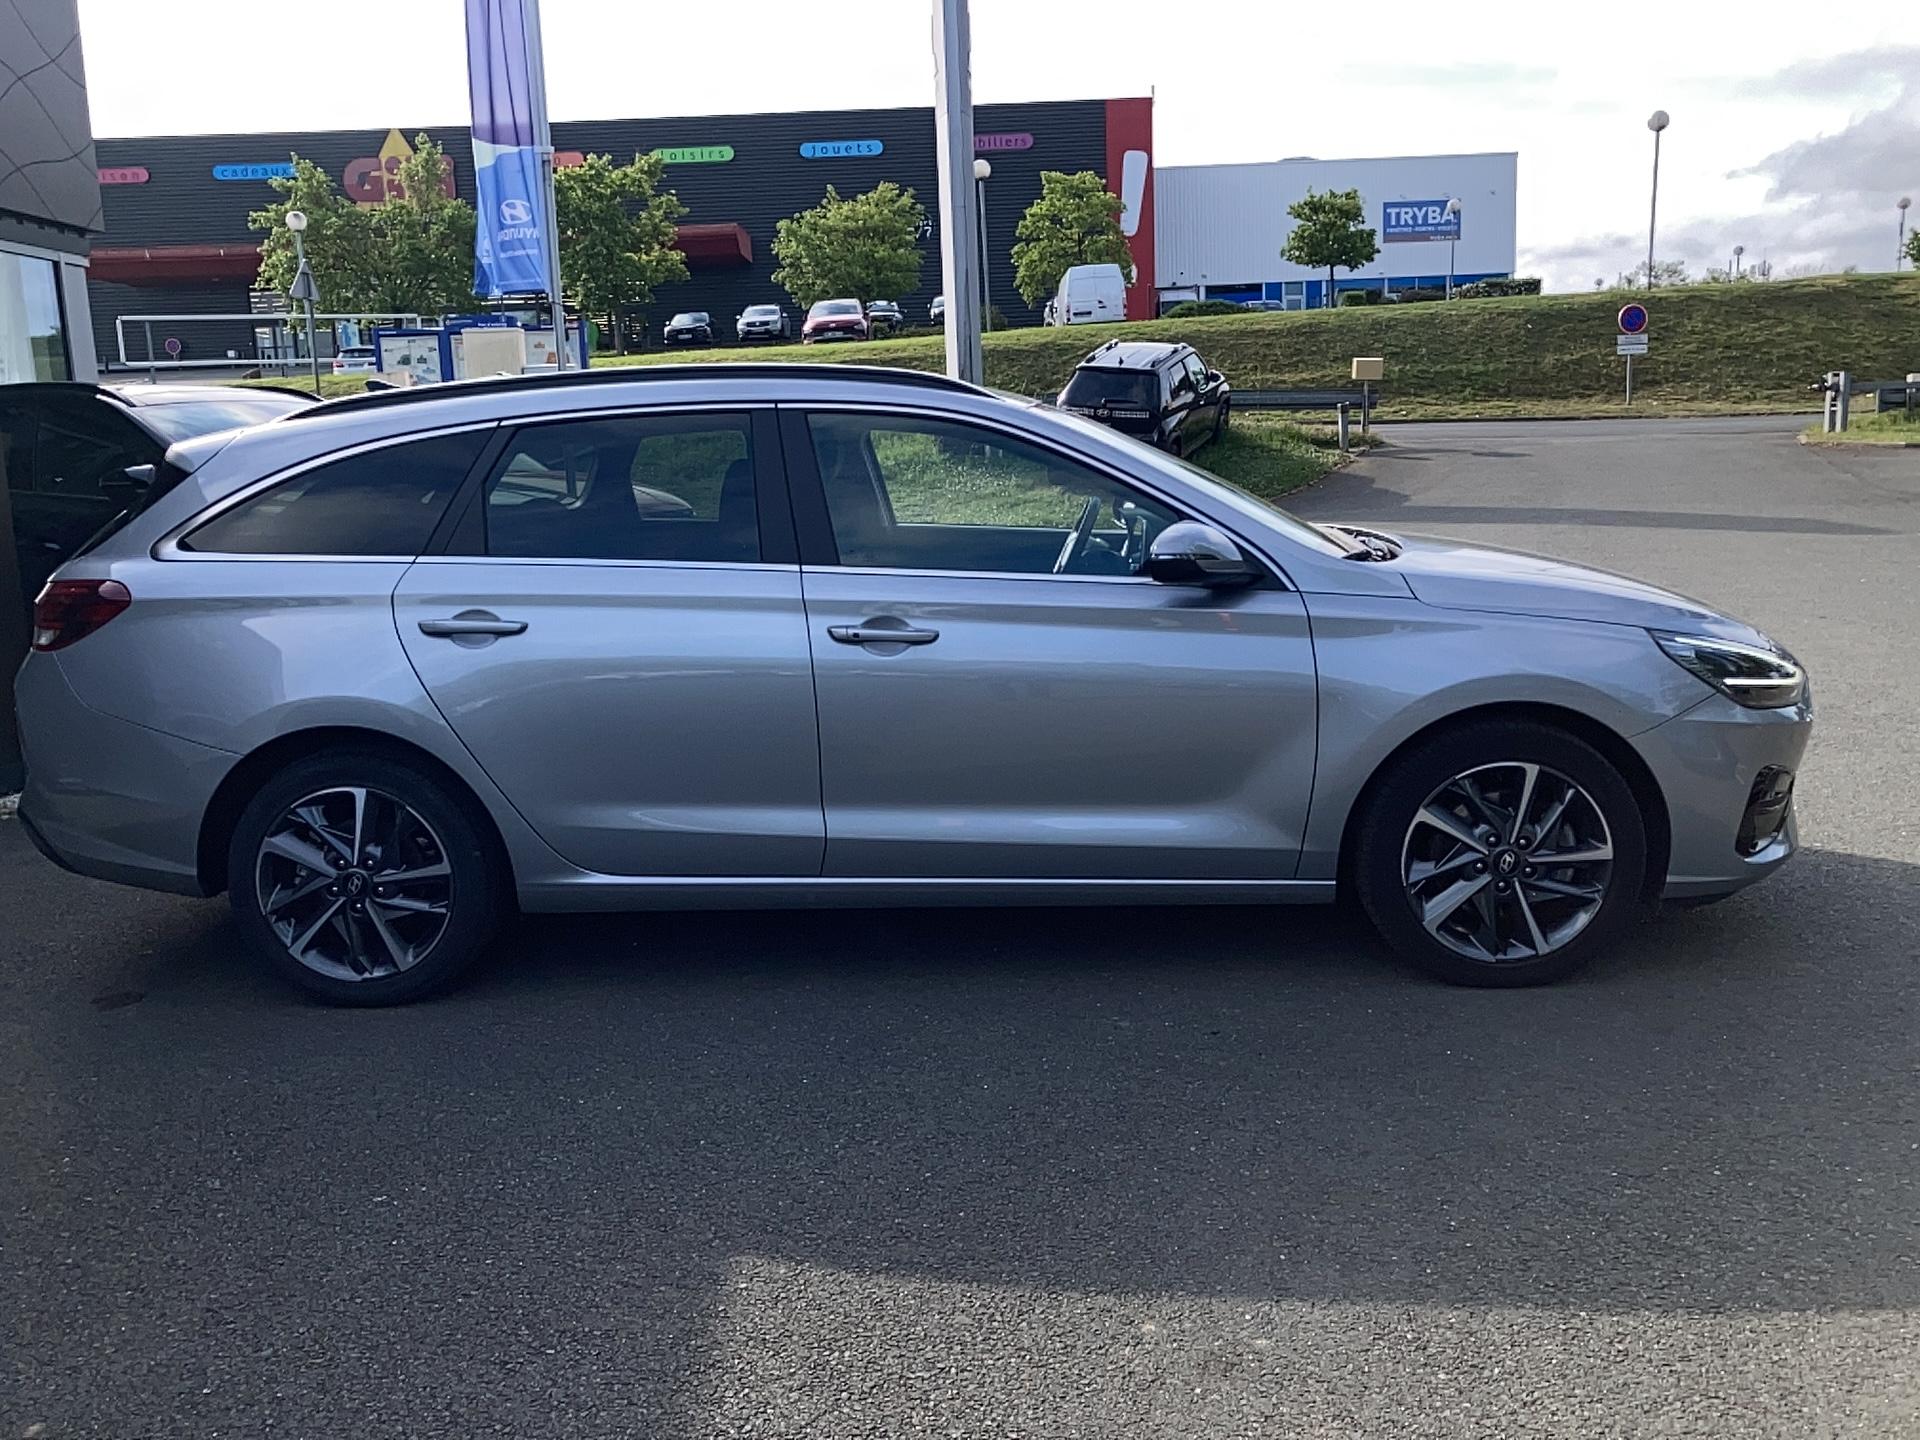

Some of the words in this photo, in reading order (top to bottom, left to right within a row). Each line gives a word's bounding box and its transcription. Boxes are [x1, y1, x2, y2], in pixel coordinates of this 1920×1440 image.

[810, 143, 874, 157] jouets
[220, 166, 289, 178] cadeaux
[1386, 205, 1457, 226] TRYBA
